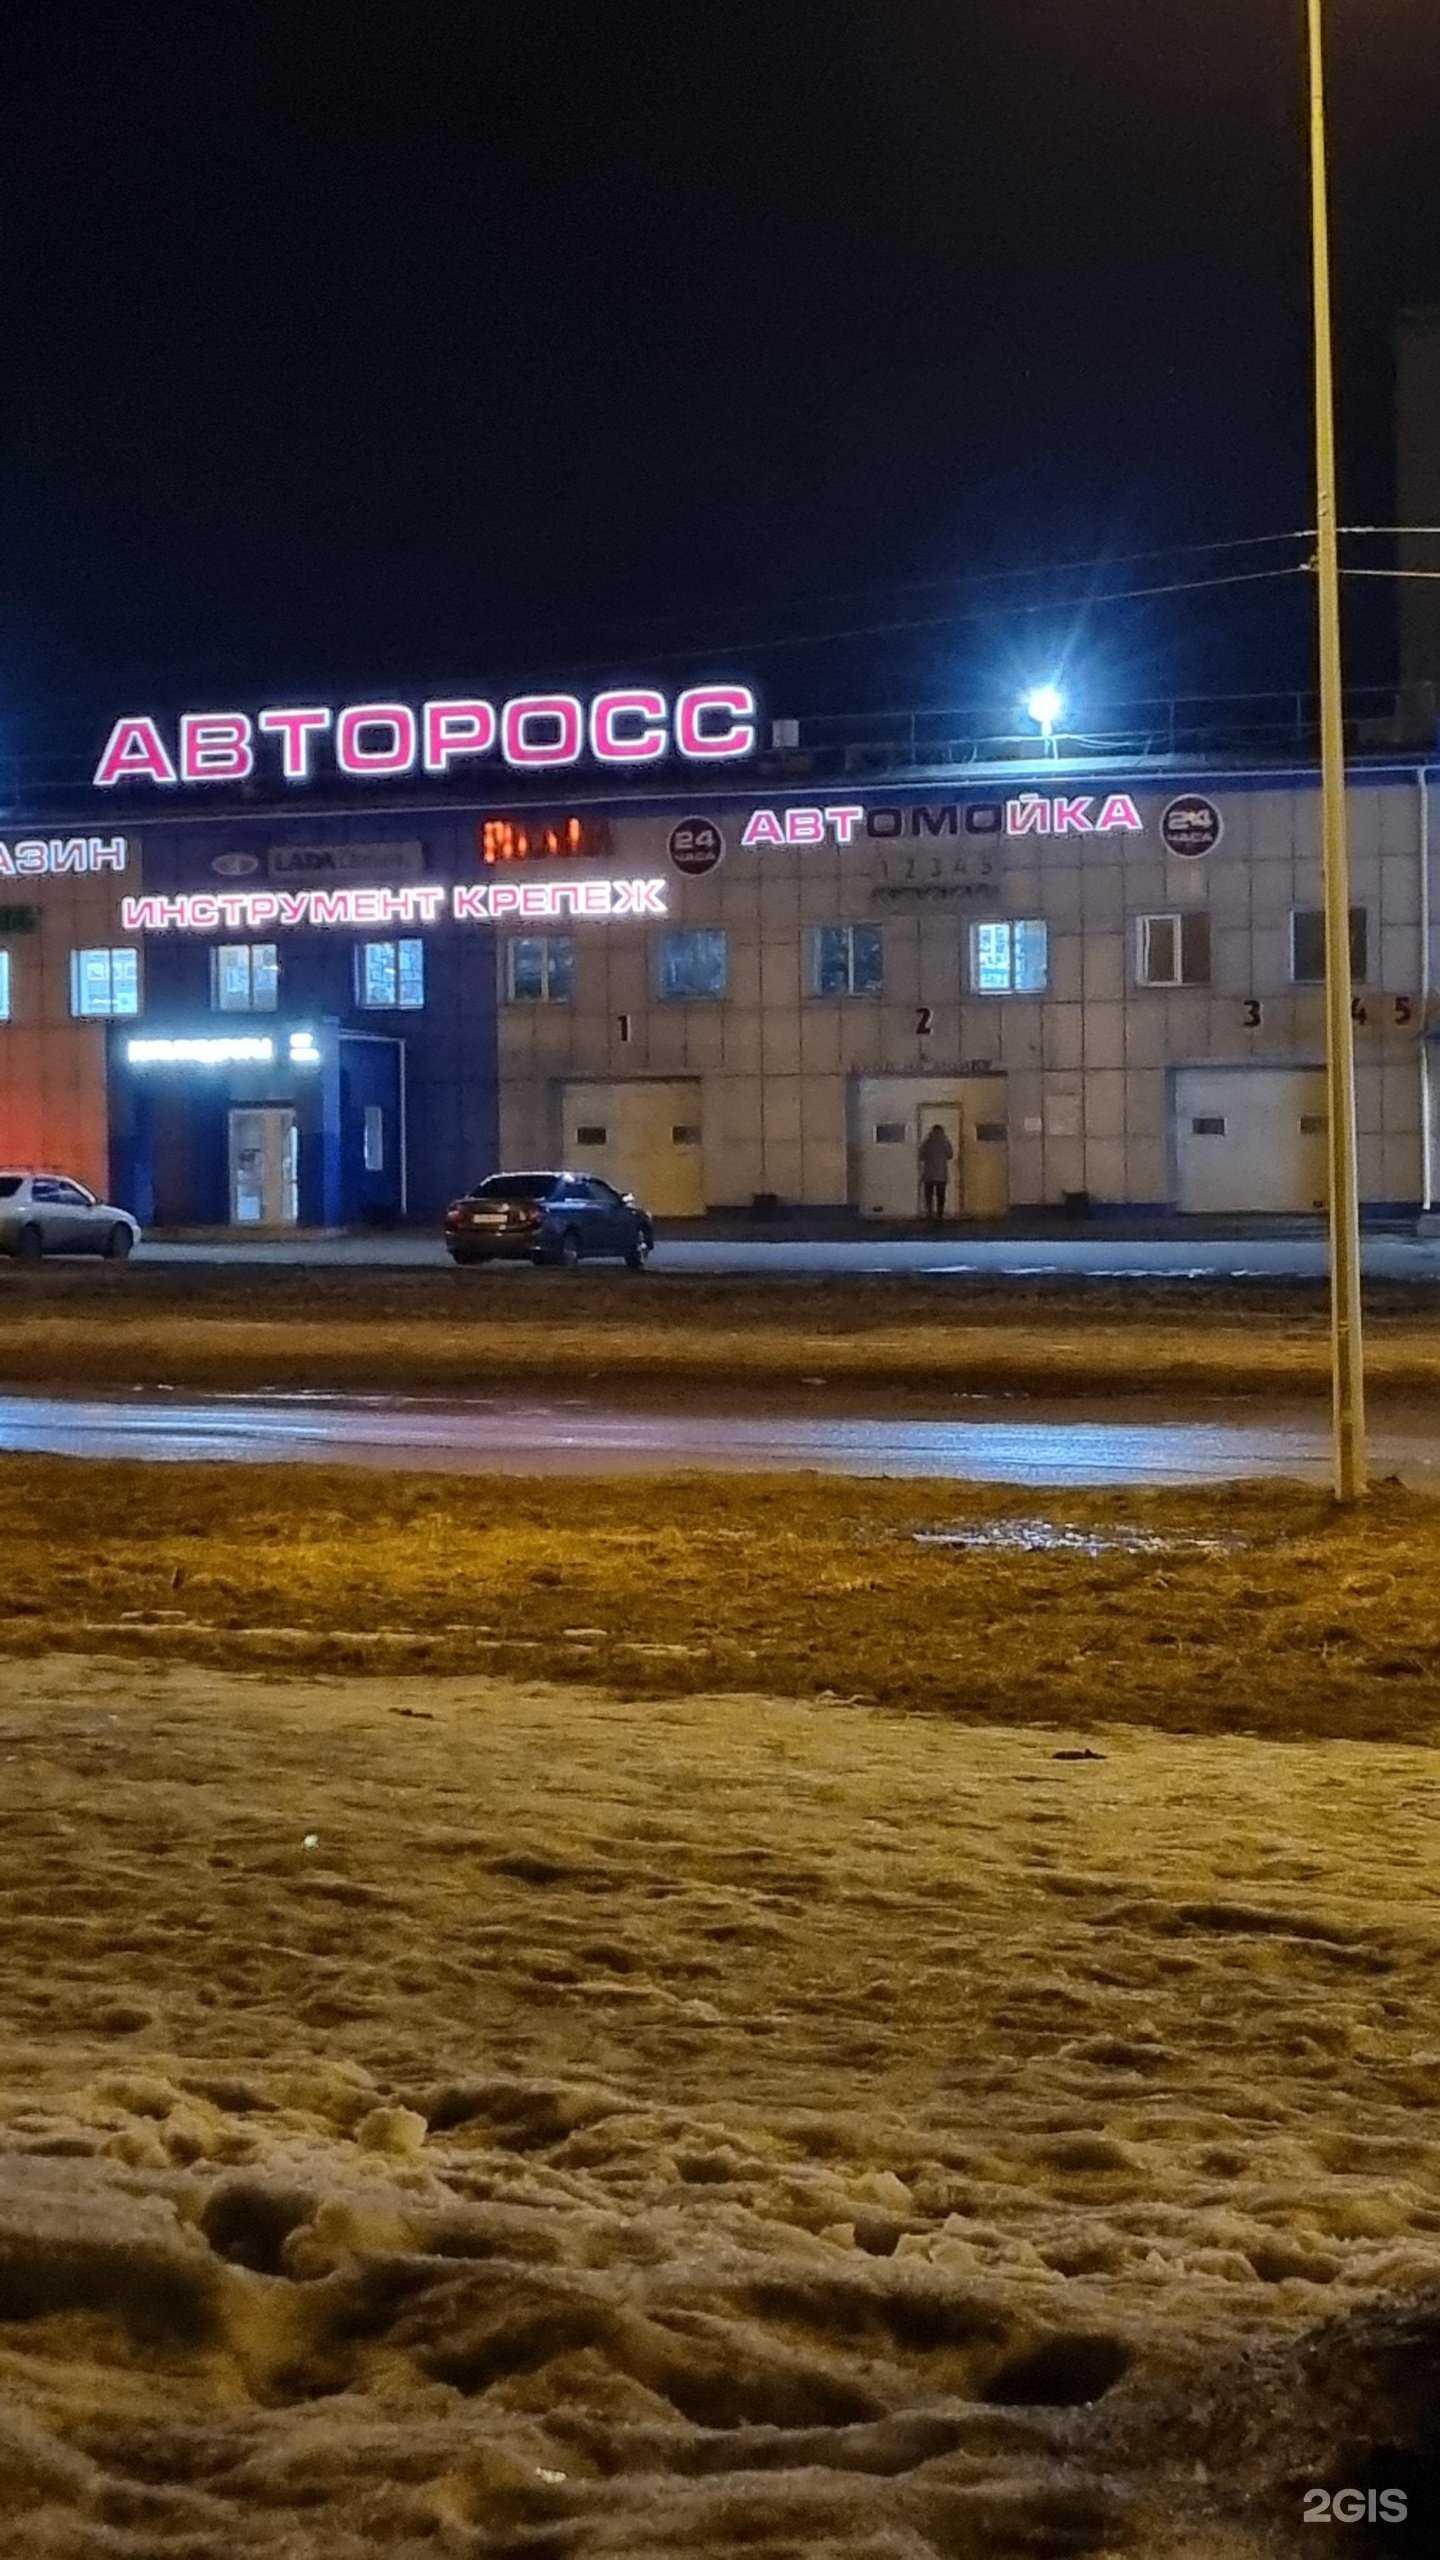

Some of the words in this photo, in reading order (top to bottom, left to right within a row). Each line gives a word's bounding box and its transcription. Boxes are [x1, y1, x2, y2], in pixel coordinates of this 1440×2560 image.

[92, 686, 755, 786] АВТОРОСС
[742, 793, 1143, 845] АВТОМОЙКА
[1168, 809, 1212, 830] 24
[674, 830, 715, 849] 24
[121, 885, 445, 931] ИНСТРУМЕНТ
[453, 878, 668, 920] КРЕПЕЖ
[915, 1008, 932, 1035] 2
[1243, 1000, 1262, 1027] 3
[1351, 998, 1367, 1025] 4
[1395, 996, 1412, 1024] 5
[617, 1015, 630, 1042] 1
